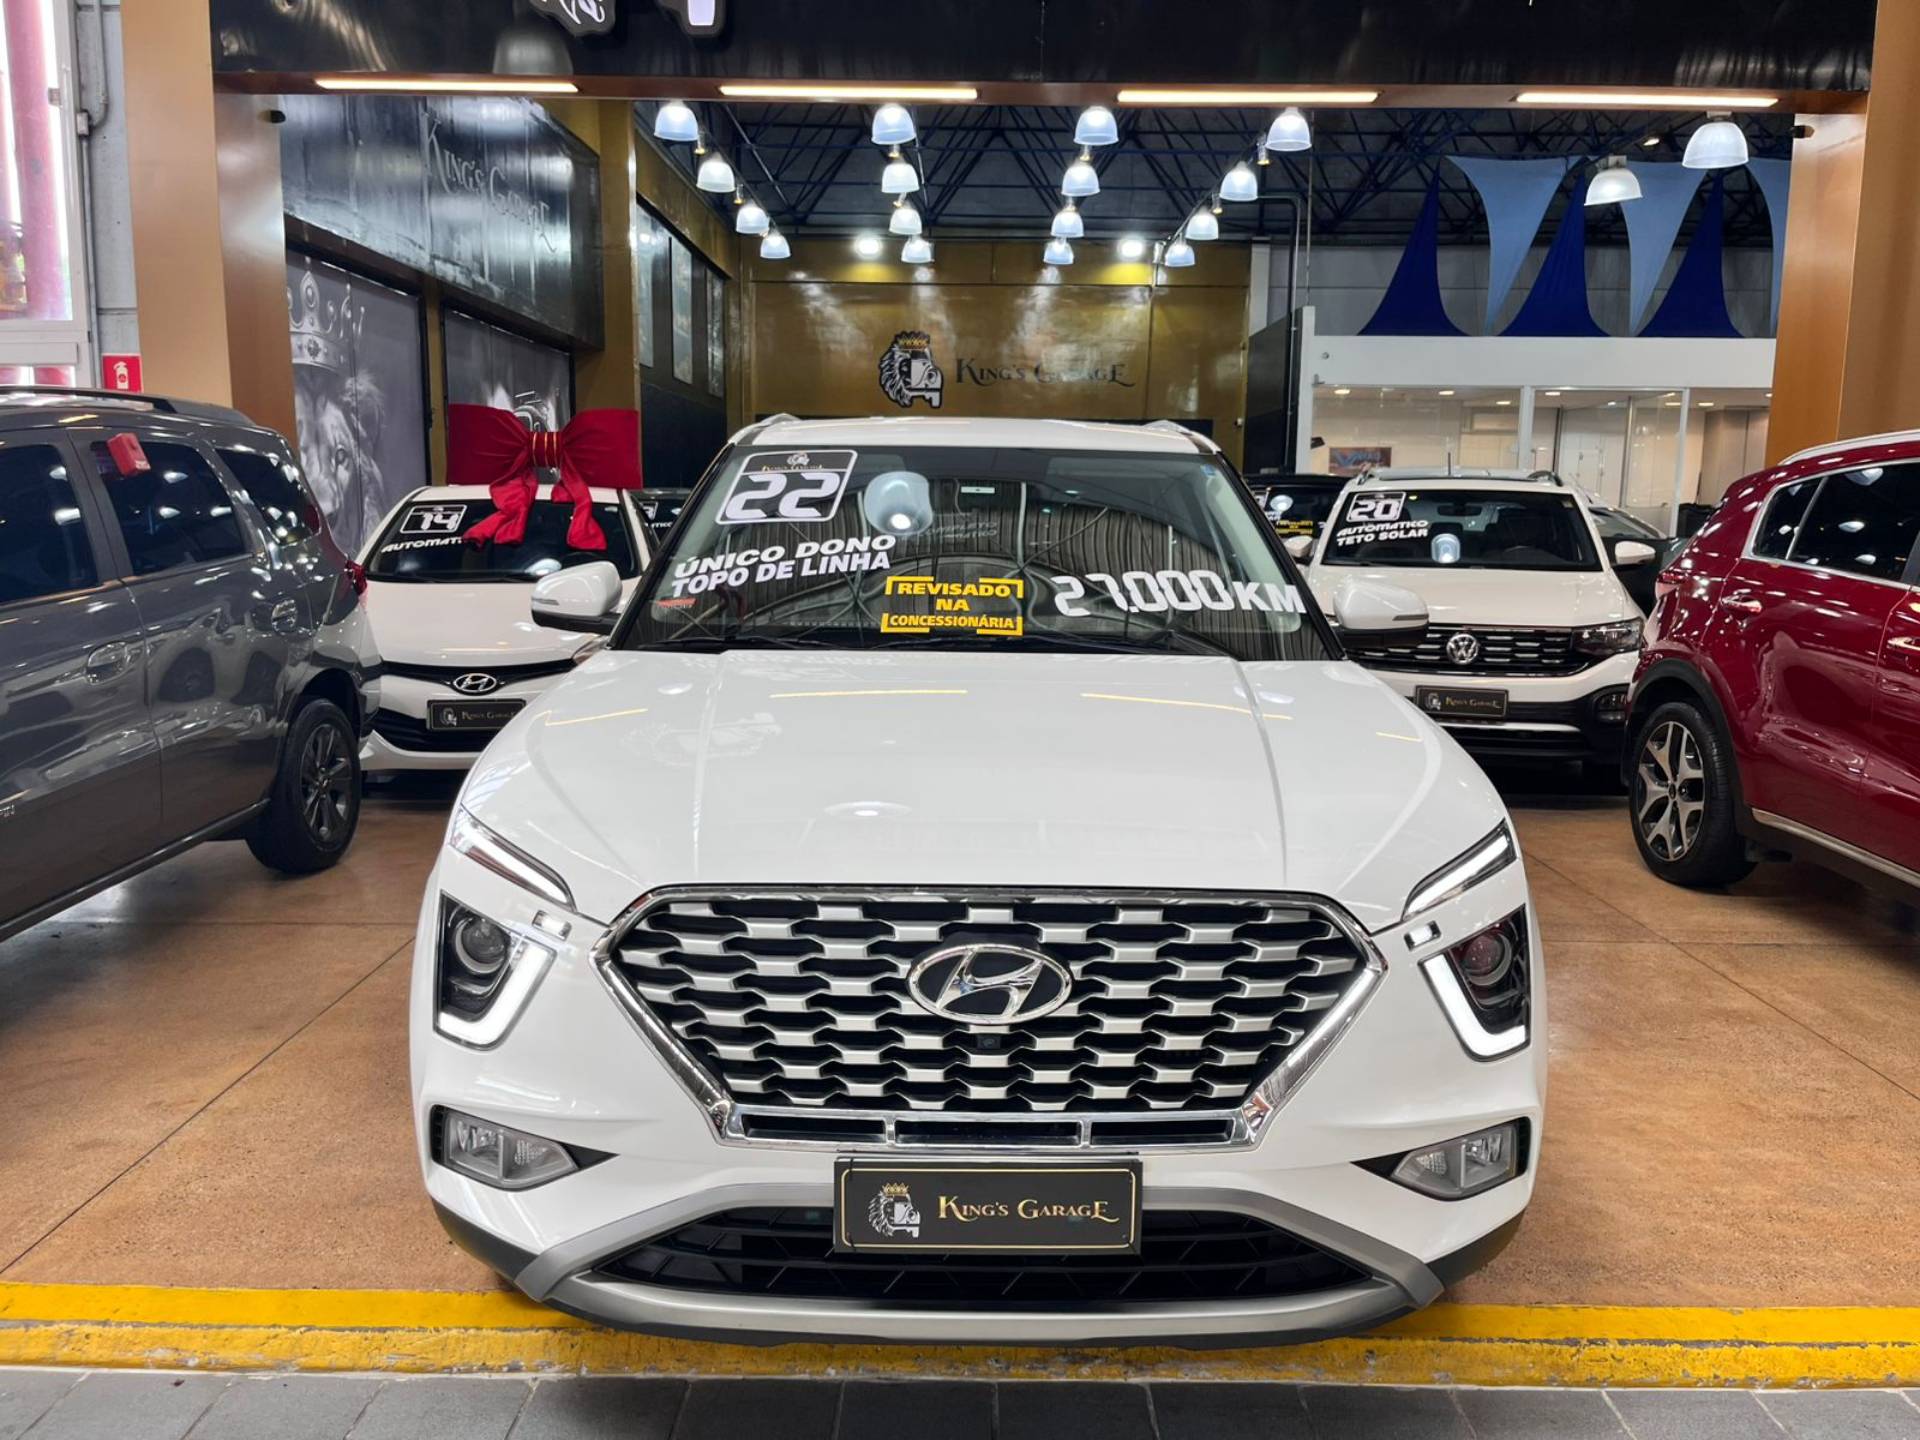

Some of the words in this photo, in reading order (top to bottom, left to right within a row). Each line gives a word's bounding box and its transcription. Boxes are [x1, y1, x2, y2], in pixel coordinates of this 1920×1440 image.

[956, 357, 1026, 387] KING'S
[1034, 362, 1136, 388] GGE
[725, 472, 841, 520] 22
[420, 511, 460, 531] 14
[1349, 499, 1401, 521] 20
[1336, 532, 1376, 547] TETO
[1378, 528, 1429, 541] SOLAR
[674, 545, 786, 579] ÚNICO
[794, 534, 897, 559] DONO
[671, 567, 750, 598] TOPO
[754, 560, 796, 583] DE
[800, 551, 891, 577] LINHA
[897, 582, 1012, 598] REVISADO
[935, 598, 970, 611] NA
[889, 614, 1015, 629] CONCESSIONÁRIA
[938, 1194, 1010, 1223] KING'S
[1017, 1198, 1120, 1224] GARAGE
